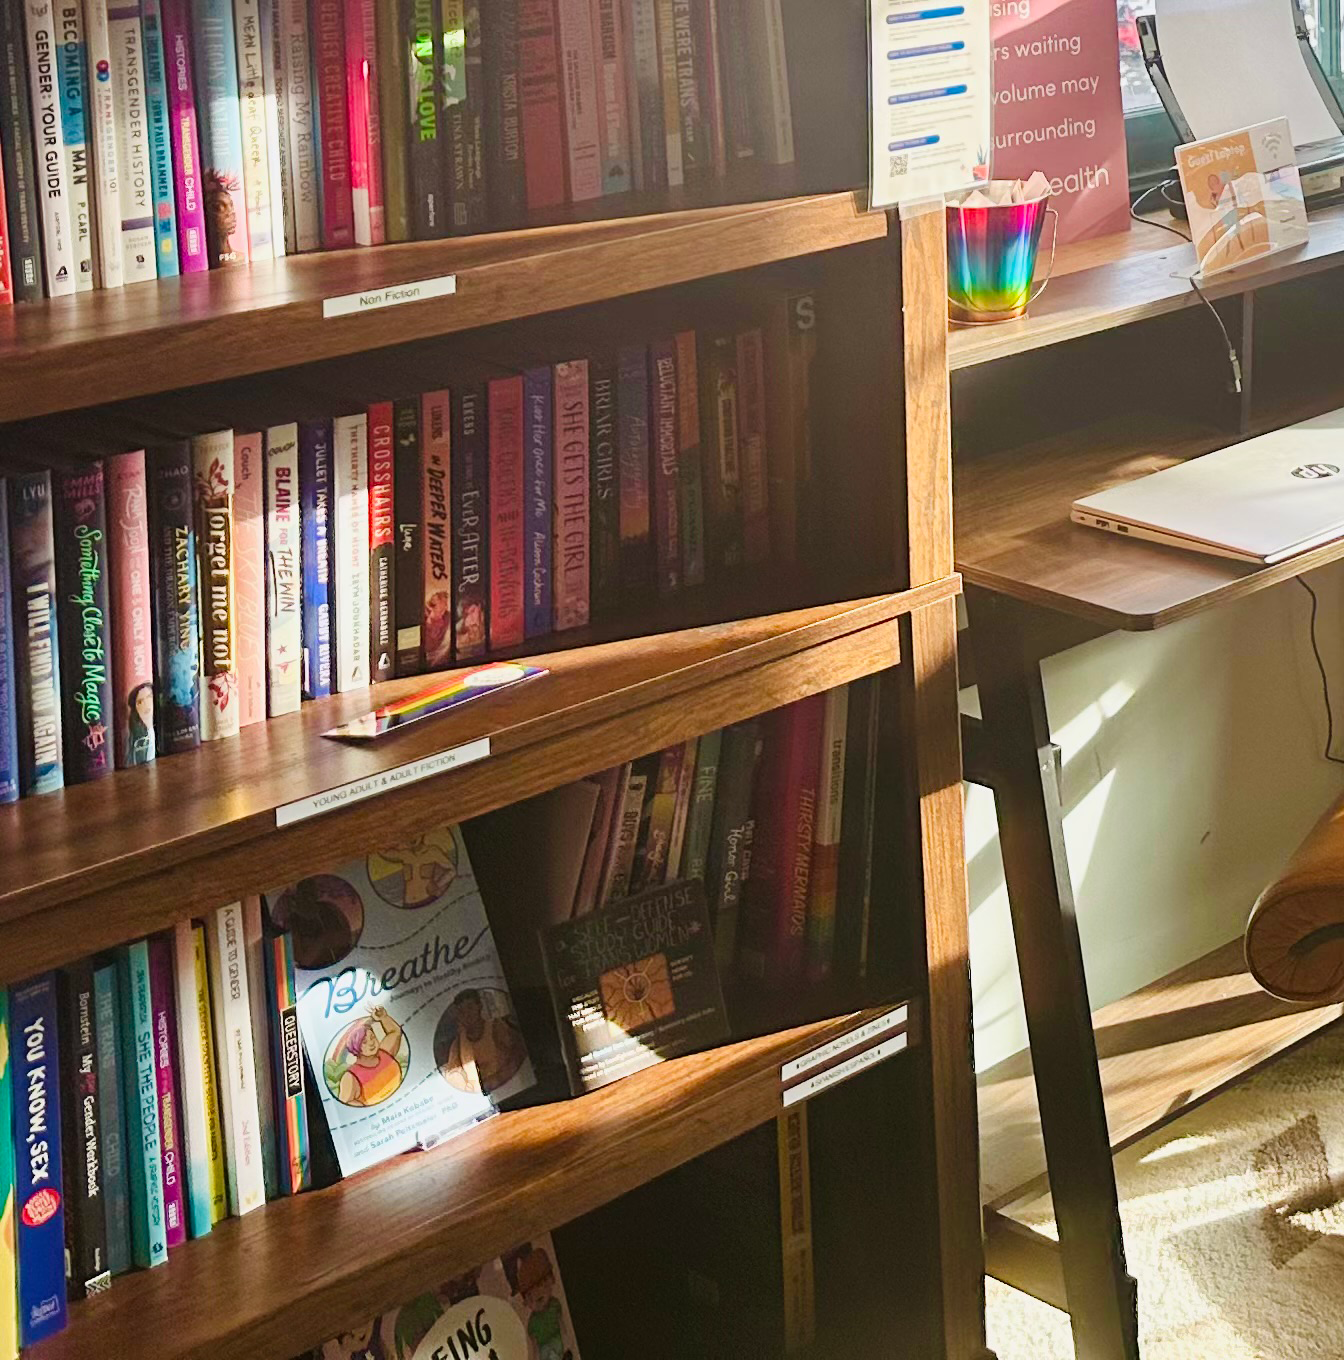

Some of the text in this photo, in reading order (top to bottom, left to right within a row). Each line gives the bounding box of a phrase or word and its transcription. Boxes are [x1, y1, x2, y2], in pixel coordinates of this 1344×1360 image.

[243, 15, 257, 49] MEAN
[321, 3, 340, 59] GENDER
[675, 16, 693, 55] WERE
[1014, 34, 1082, 63] waiting
[124, 28, 142, 138] TRANSGENDER
[175, 34, 188, 90] HISTORIES
[502, 72, 518, 110] KRISTA
[679, 57, 697, 108] TRANS
[991, 81, 1057, 105] volume
[1061, 74, 1100, 105] may
[34, 28, 62, 198] GENDER: YOUR GUIDE
[62, 7, 88, 185] BECOMING MAN
[291, 33, 314, 203] Raising My Rainbow
[324, 65, 343, 134] CREATIVE
[419, 90, 437, 141] LOVE
[104, 87, 115, 173] TRANSGENDER
[504, 116, 520, 161] BURTON
[132, 144, 147, 208] HISTORY
[329, 140, 346, 180] CHILD
[1049, 164, 1110, 198] ealth
[359, 285, 421, 307] Non Fiction
[656, 357, 676, 415] RELUCTANT
[240, 447, 253, 481] Couch
[315, 443, 329, 483] JULIET
[595, 379, 614, 500] BRIAR GIRLS
[659, 418, 680, 476] IMMORTALS
[22, 484, 46, 501] LYU
[373, 424, 392, 538] CROSSHAIRS
[562, 401, 586, 577] SHE GETS THE GIRL
[1295, 461, 1336, 480] hp
[275, 466, 297, 614] BLAINE THE WIN
[426, 467, 449, 580] DEEPER WATERS
[459, 490, 481, 592] EVER AFTER
[175, 524, 192, 651] ZACHARY YING
[203, 507, 232, 669] forget me not
[69, 524, 106, 724] Something Close Magic
[132, 607, 146, 678] ONLY NOW
[27, 593, 57, 765] WILL FIND YOU AGAIN
[312, 754, 457, 809] YOUNG ADULT ADULT FICTION
[695, 765, 716, 803] FINE
[830, 739, 844, 805] transitions
[722, 825, 746, 903] Honor Girl
[789, 789, 816, 936] THIRSTY MERMAIDS
[229, 963, 242, 1002] GENDER
[302, 927, 490, 1019] Breathe
[23, 1016, 46, 1061] YOU
[78, 991, 92, 1045] Bornstein
[284, 1015, 300, 1090] QUEERSTORY
[799, 1050, 830, 1068] GRAPHIC
[25, 1065, 48, 1143] KNOW,
[82, 1095, 97, 1139] Gender
[137, 1031, 158, 1151] SHE THE PEOPLE
[158, 1010, 177, 1186] HISTORIES CHILD
[30, 1140, 49, 1184] SEX
[85, 1139, 100, 1198] Workbook
